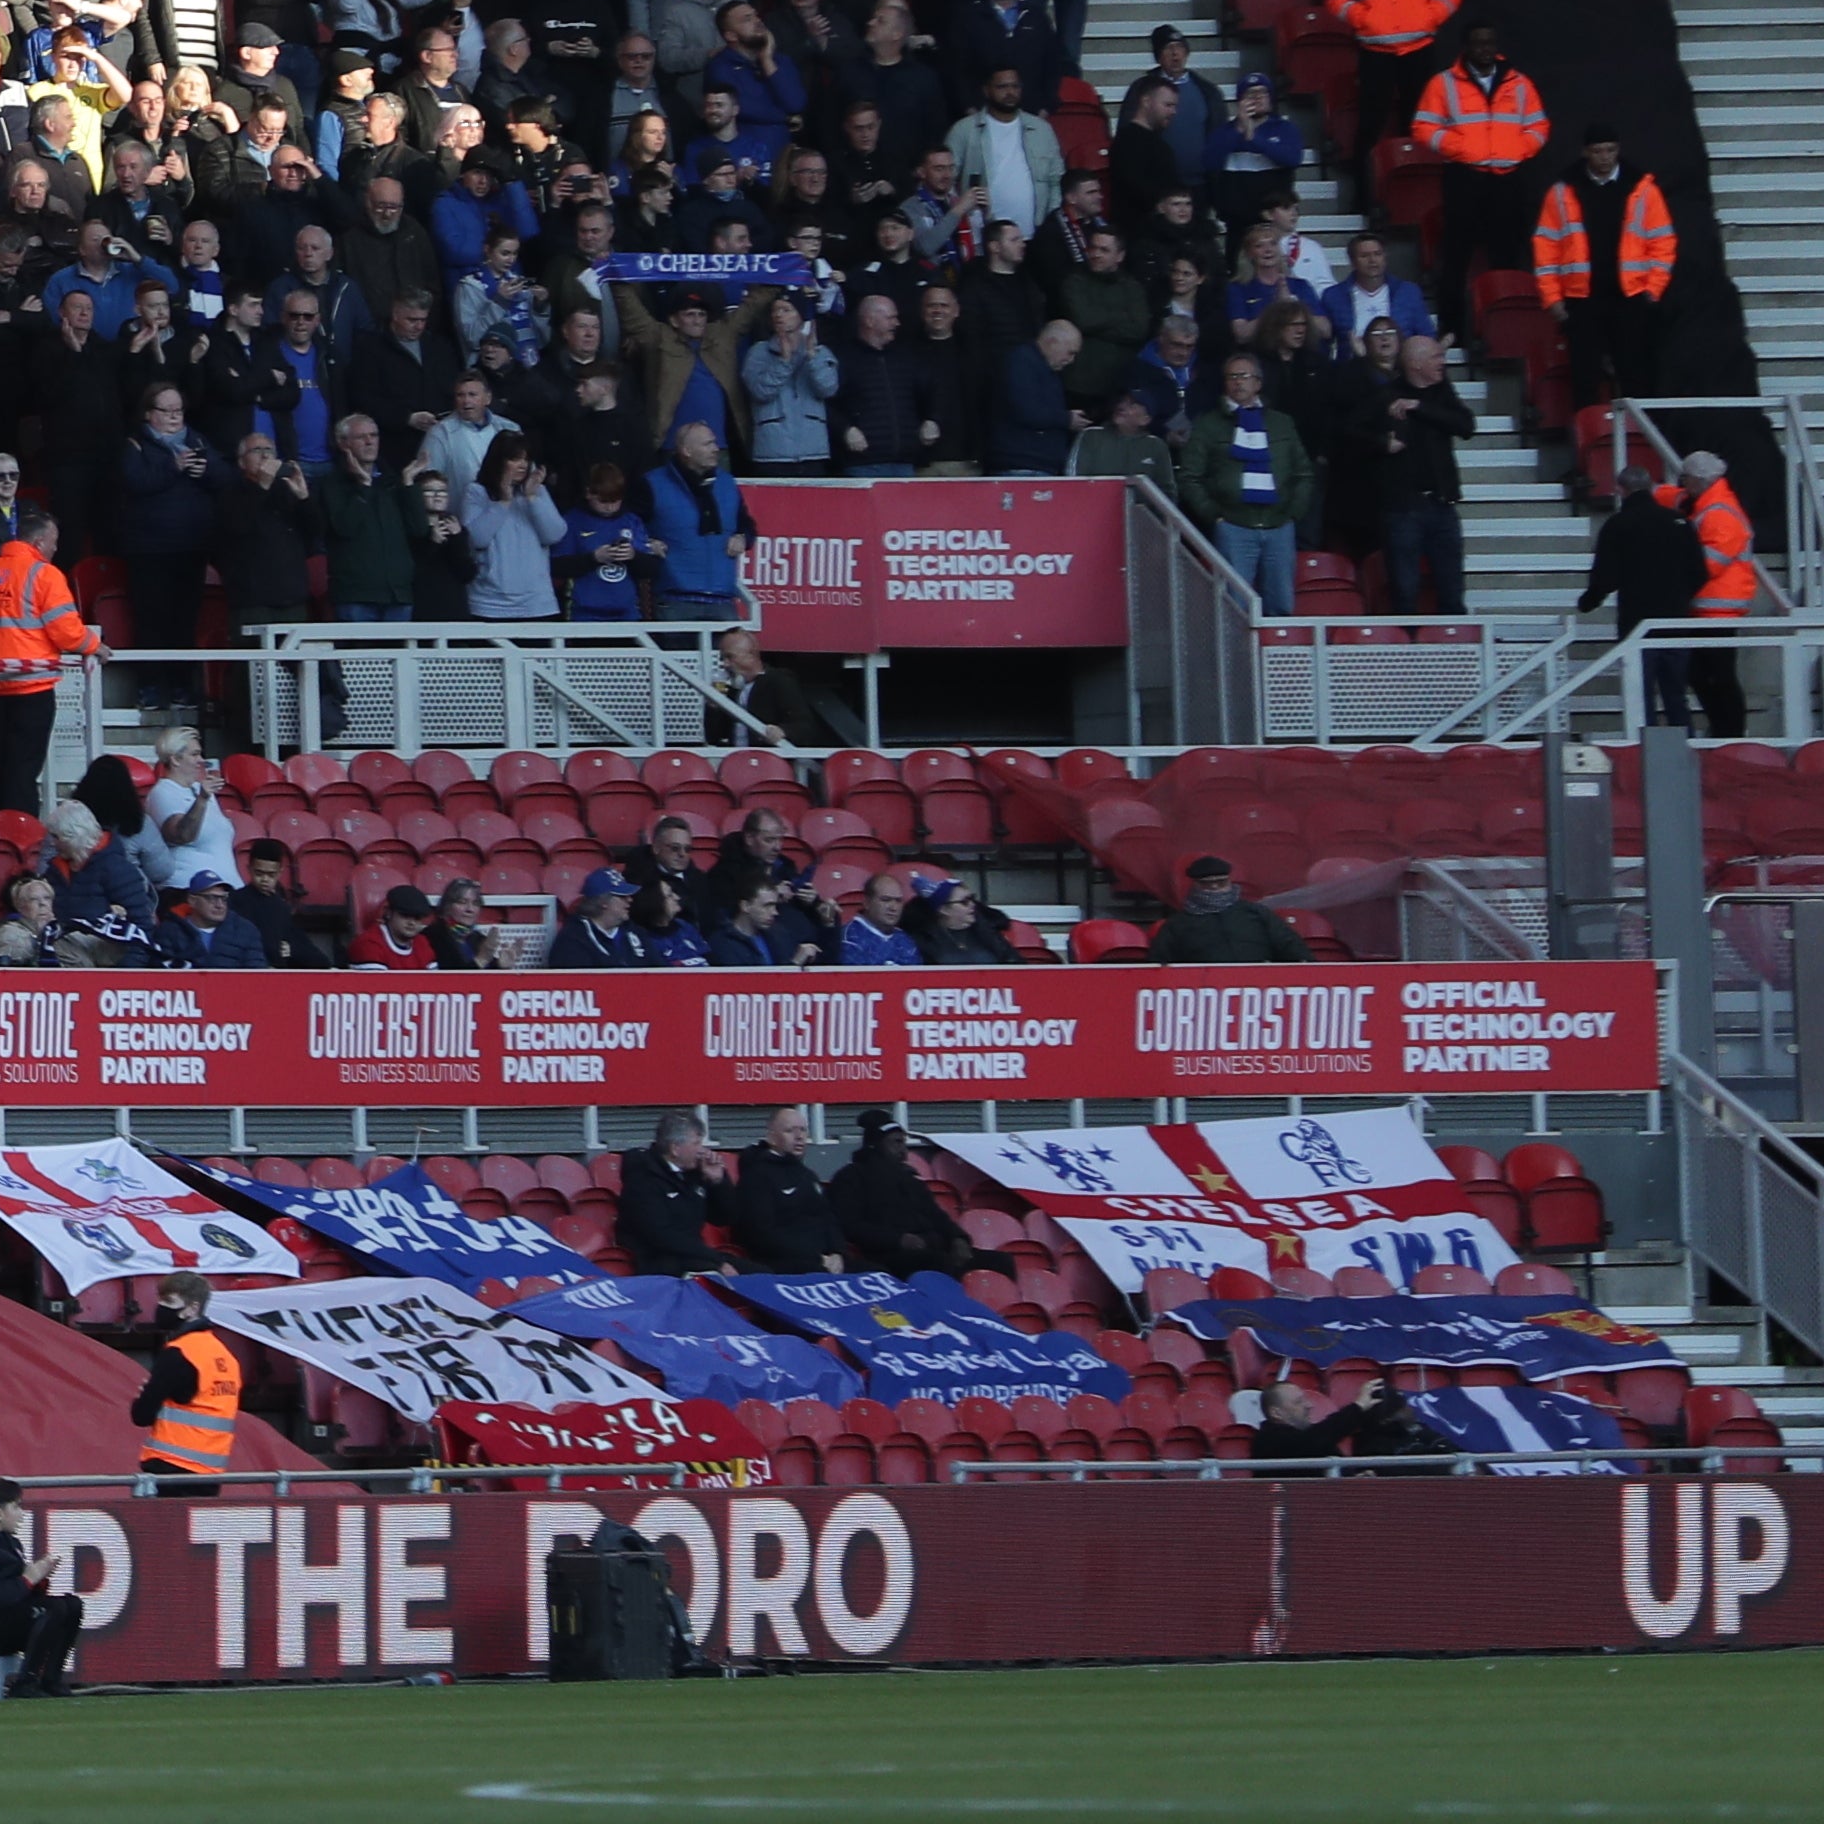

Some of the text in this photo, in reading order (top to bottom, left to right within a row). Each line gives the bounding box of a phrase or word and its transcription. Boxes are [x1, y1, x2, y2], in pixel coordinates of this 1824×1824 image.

[657, 254, 780, 273] CHELSEA FC
[883, 529, 1011, 551] OFFICIAL
[884, 554, 1074, 576] TECHNOLOGY
[779, 590, 863, 606] SOLUTIONS
[887, 580, 1015, 601] PARTNER
[99, 989, 202, 1017] OFFICIAL
[499, 989, 601, 1017] OFFICIAL
[904, 988, 1022, 1016] OFFICIAL
[1401, 981, 1547, 1009] OFFICIAL
[309, 993, 482, 1059] CORNERSTONE
[704, 992, 883, 1059] CORNERSTONE
[1134, 986, 1375, 1053] CORNERSTONE
[1402, 1012, 1616, 1042] TECHNOLOGY
[99, 1023, 252, 1052] TECHNOLOGY
[499, 1022, 650, 1050] TECHNOLOGY
[905, 1019, 1077, 1049] TECHNOLOGY
[99, 1056, 207, 1085] PARTNER
[339, 1063, 481, 1083] BUSINESS SOLUTIONS
[501, 1055, 606, 1084] PARTNER
[735, 1061, 883, 1082] BUSINESS SOLUTIONS
[905, 1052, 1027, 1082] PARTNER
[1173, 1052, 1373, 1076] BUSINESS SOLUTIONS
[1403, 1044, 1551, 1074] PARTNER
[3, 1063, 79, 1084] SOLUTIONS
[1103, 1194, 1396, 1230] CHELSEA
[775, 1272, 918, 1309] CHELSE
[1621, 1481, 1791, 1640] UP
[187, 1503, 454, 1669] THE
